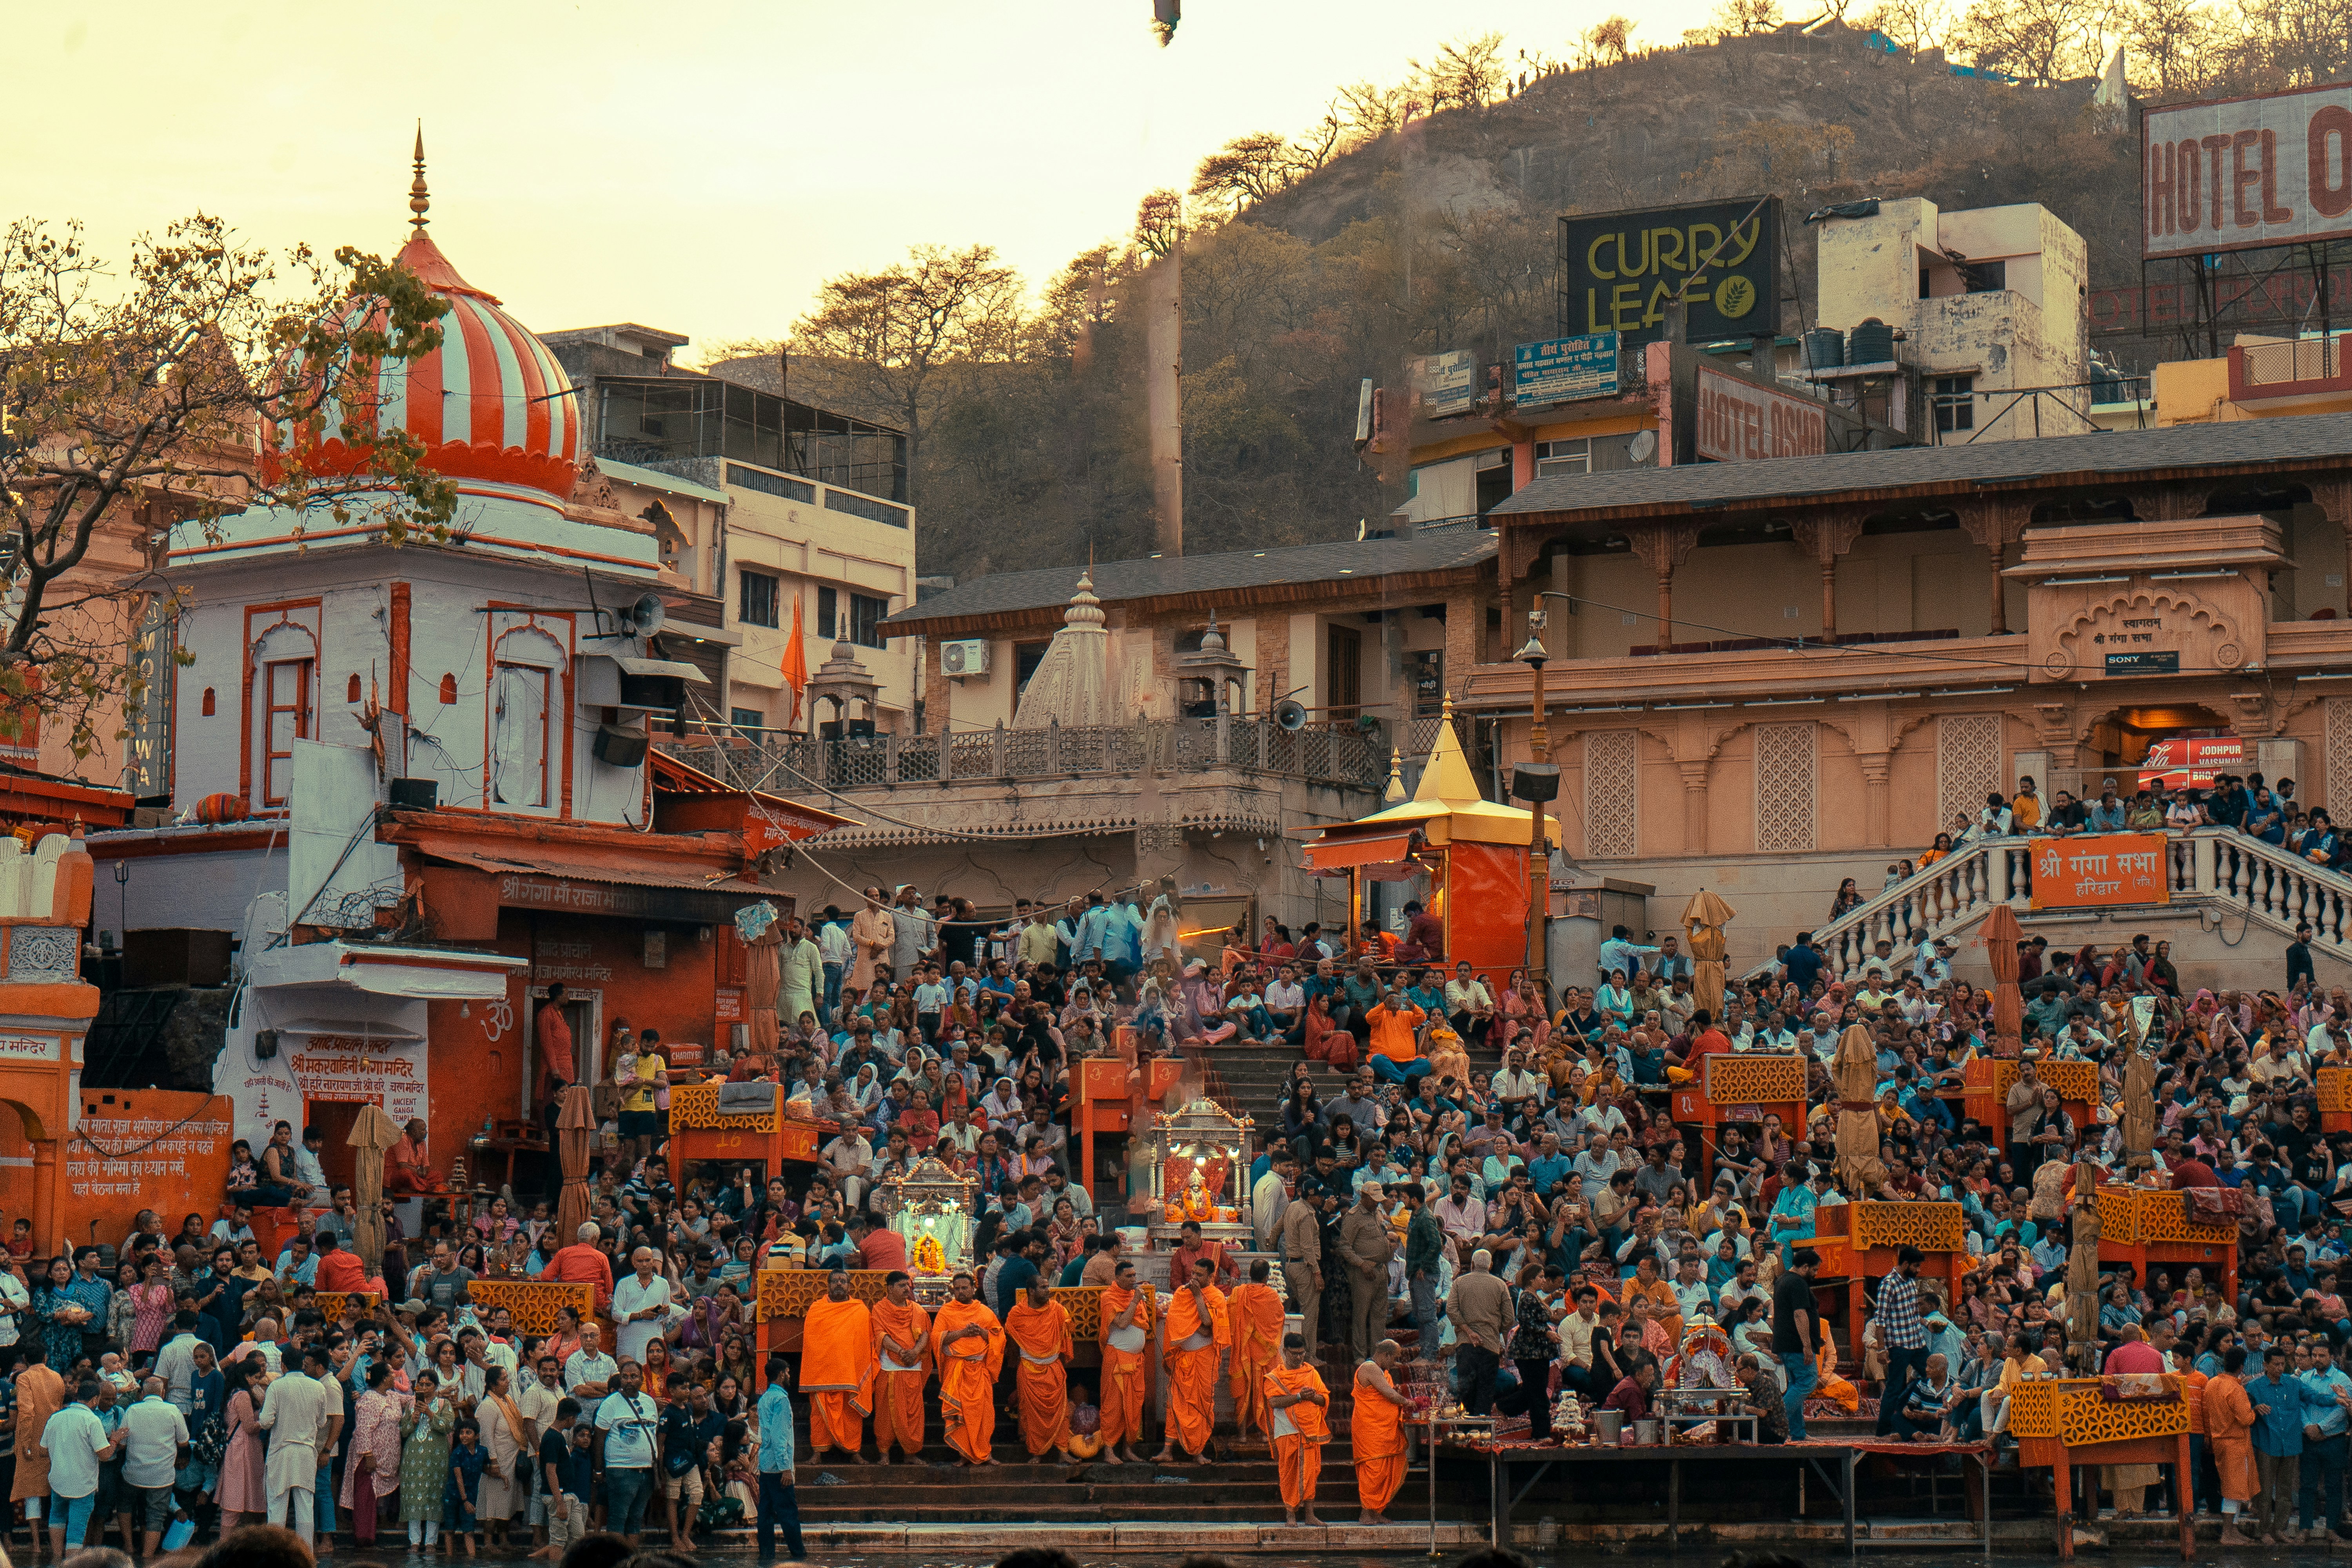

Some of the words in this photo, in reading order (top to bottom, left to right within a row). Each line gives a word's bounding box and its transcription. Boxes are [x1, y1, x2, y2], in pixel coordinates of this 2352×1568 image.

[2151, 128, 2294, 238] HOTEL
[1588, 216, 1760, 279] CURRY
[1588, 275, 1710, 334] LEAF
[2088, 285, 2195, 325] OTEL
[1703, 388, 1770, 459] HOTEL
[2122, 618, 2161, 630] स्वागतम्
[2094, 633, 2105, 644] श्री
[2109, 632, 2127, 643] गंगा
[2131, 633, 2152, 642] सभा
[2199, 745, 2241, 756] JODHPUR
[2040, 849, 2062, 878] श्री
[2069, 850, 2109, 877] गंगा
[2116, 852, 2158, 874] सभा
[502, 876, 520, 899] श्री
[521, 878, 553, 902] गंगा
[573, 889, 602, 907] राजा
[2075, 877, 2122, 897] हरिद्वार
[584, 962, 613, 982] मन्दिर
[9, 1038, 47, 1056] मन्दिर
[671, 1051, 695, 1061] CHARITY
[291, 1053, 305, 1073] श्री
[384, 1058, 414, 1078] मन्दिर
[298, 1075, 309, 1091] श्री
[310, 1076, 323, 1091] हरि
[323, 1079, 351, 1092] नारायण
[352, 1077, 363, 1091] जी
[363, 1077, 373, 1091] श्री
[373, 1077, 386, 1092] हरि
[390, 1082, 405, 1093] चरण
[405, 1080, 425, 1094] मन्दिर
[133, 1116, 164, 1135] भगीरथ
[204, 1118, 230, 1136] मन्दिर
[111, 1136, 123, 1154] की
[156, 1140, 167, 1154] पर
[167, 1136, 187, 1155] कपड़े
[188, 1141, 196, 1154] न
[196, 1137, 215, 1156] बदलें
[789, 1130, 810, 1157] 16
[87, 1157, 100, 1176] की
[102, 1157, 129, 1177] गरिमा
[131, 1161, 143, 1177] का
[144, 1160, 167, 1176] ध्यान
[91, 1178, 115, 1196] बैठना
[116, 1183, 132, 1194] मना
[132, 1177, 141, 1197] है
